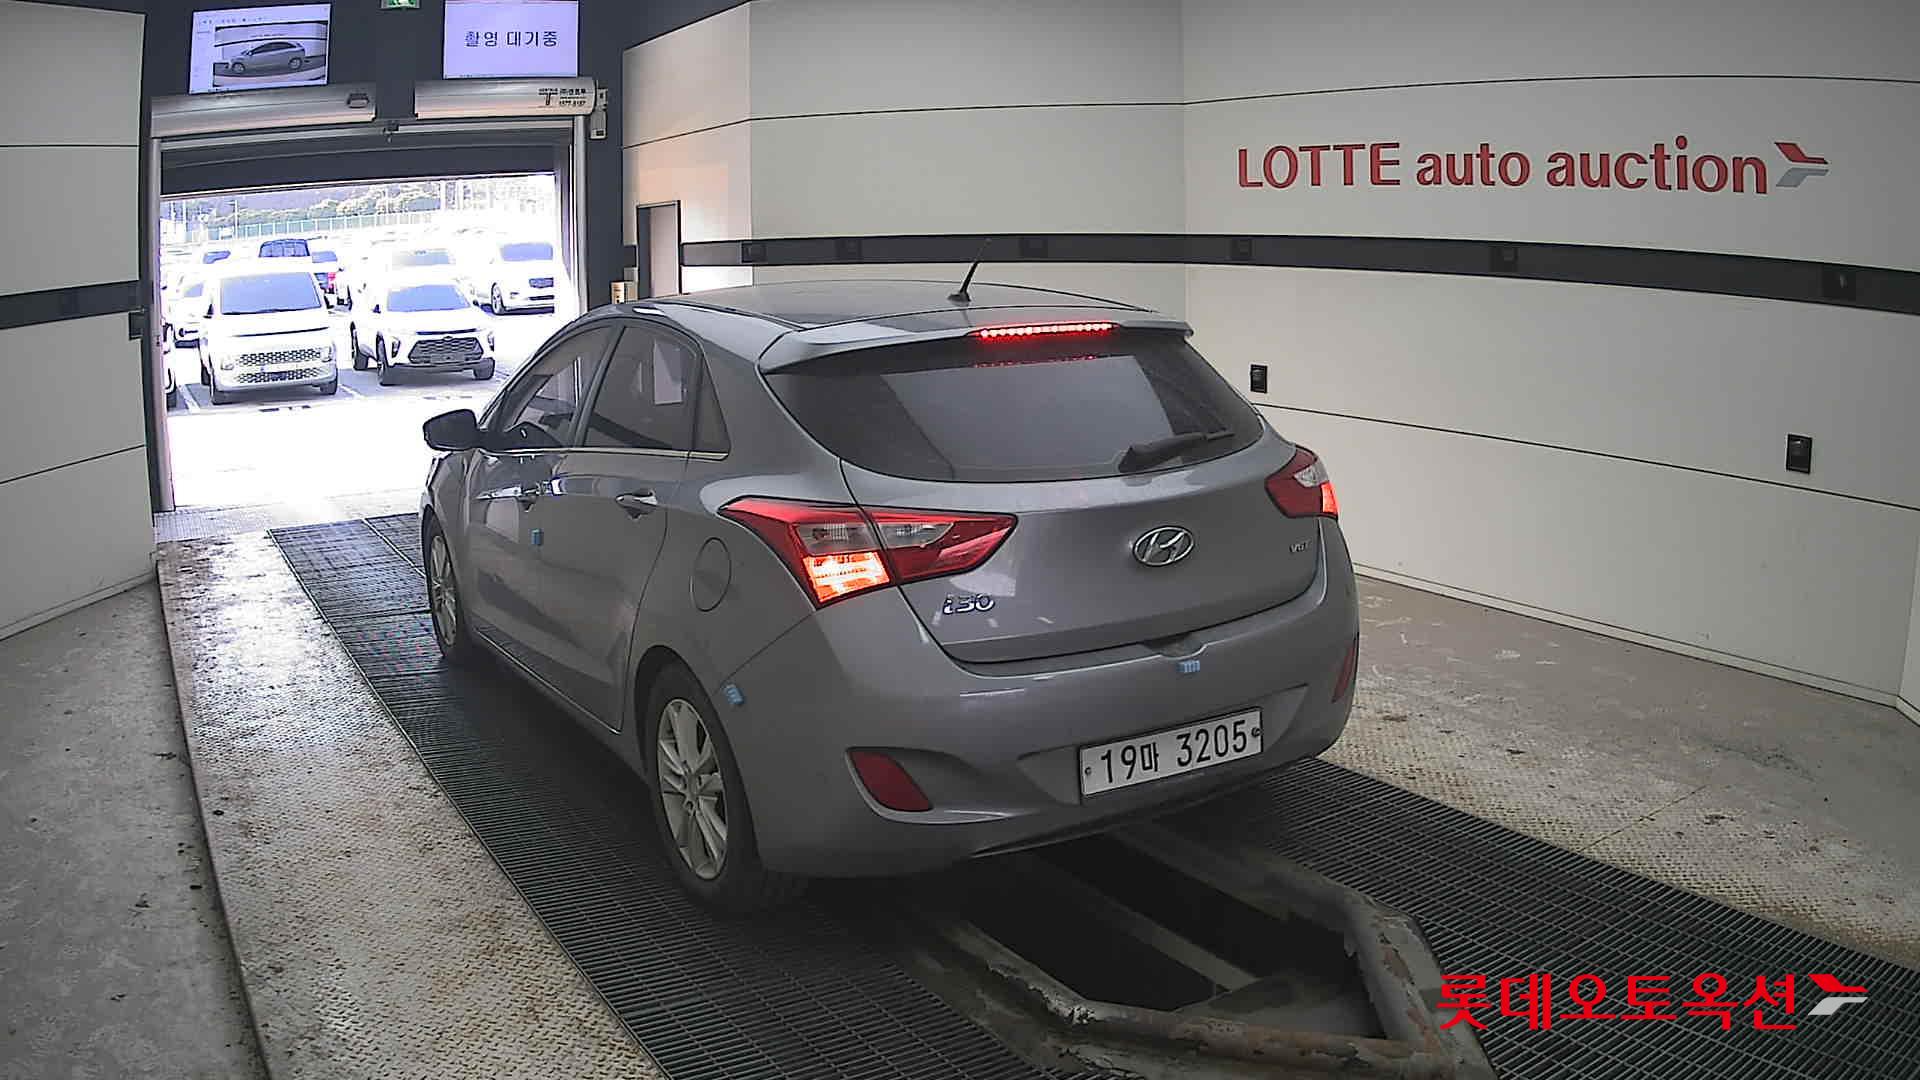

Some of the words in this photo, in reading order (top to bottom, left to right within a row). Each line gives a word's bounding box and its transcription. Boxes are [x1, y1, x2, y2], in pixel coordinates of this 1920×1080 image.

[506, 30, 558, 47] 대기중
[1238, 143, 1401, 188] LOTTE
[1416, 144, 1531, 186] auto
[1546, 136, 1768, 195] auction
[943, 593, 995, 615] i30
[1100, 744, 1160, 783] 19마
[1176, 719, 1248, 767] 3205
